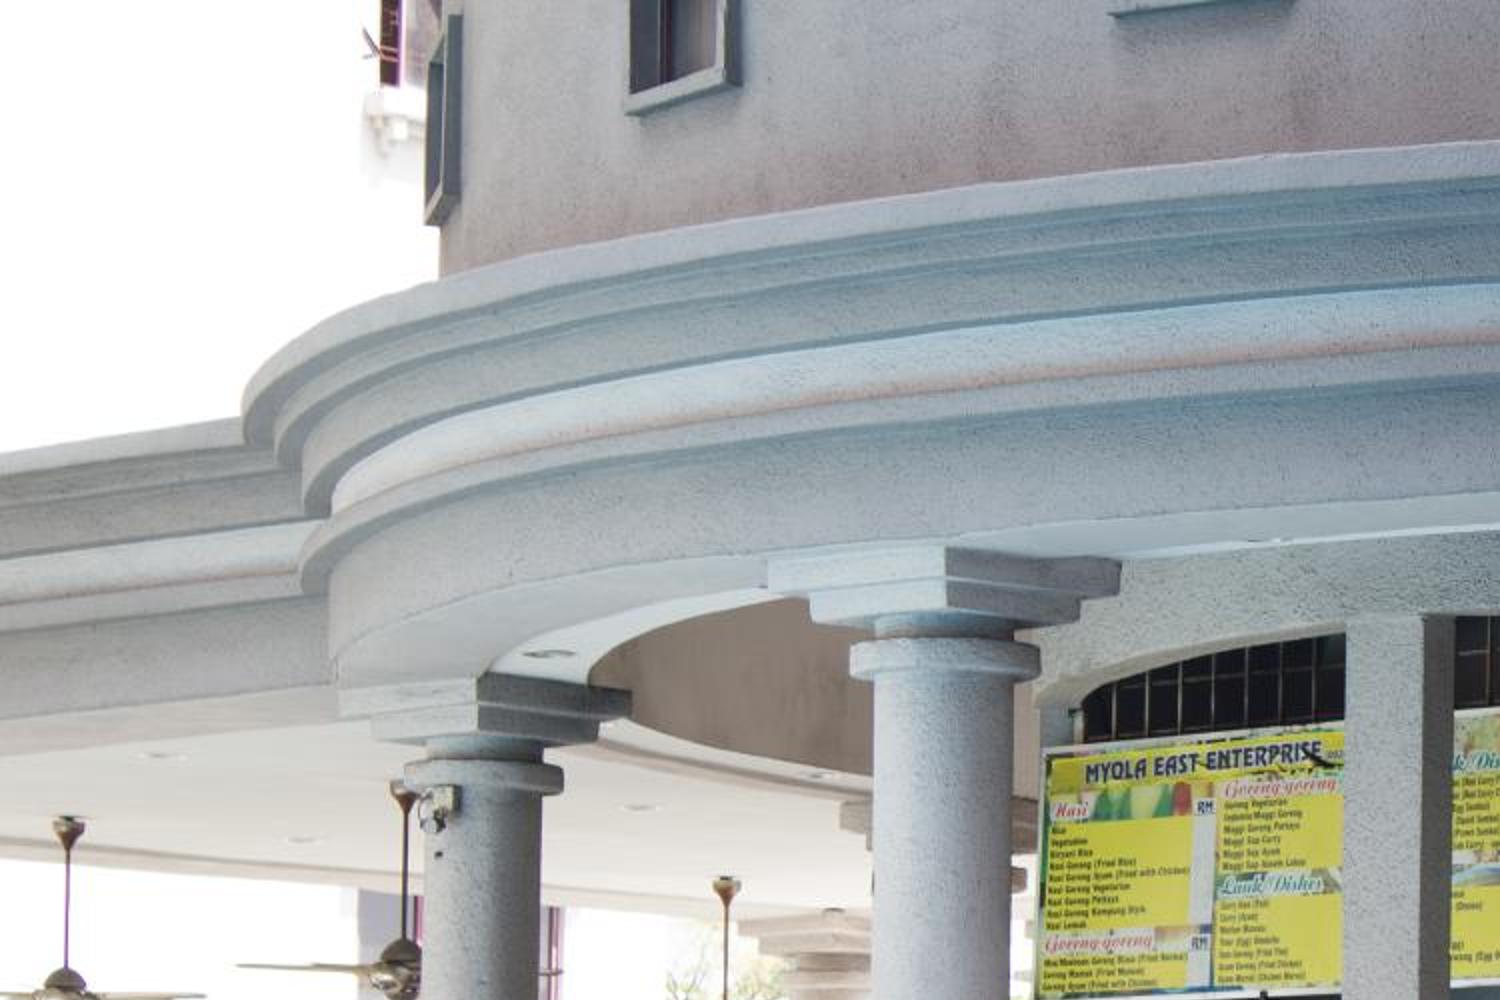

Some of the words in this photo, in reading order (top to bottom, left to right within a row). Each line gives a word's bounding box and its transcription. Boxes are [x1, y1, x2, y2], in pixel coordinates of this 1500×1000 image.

[1086, 758, 1147, 784] MYOLA
[1154, 753, 1200, 776] EAST
[1206, 741, 1322, 770] ENTERPRISE
[1197, 801, 1213, 814] RM
